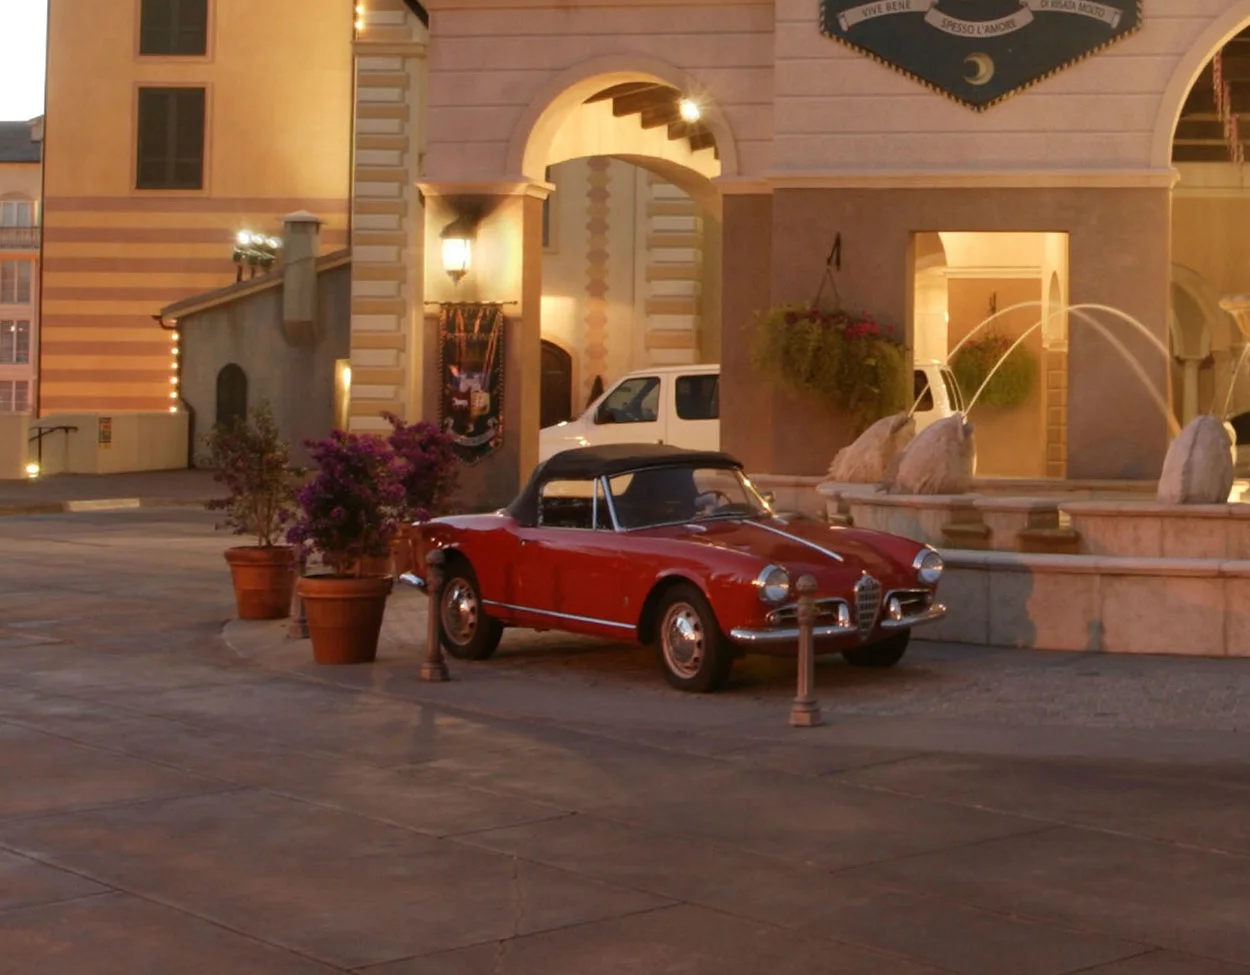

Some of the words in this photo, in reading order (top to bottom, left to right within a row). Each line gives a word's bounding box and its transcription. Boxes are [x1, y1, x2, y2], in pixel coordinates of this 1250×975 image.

[861, 3, 885, 18] VIVE
[886, 0, 912, 11] BENE
[942, 18, 975, 35] SPESSO
